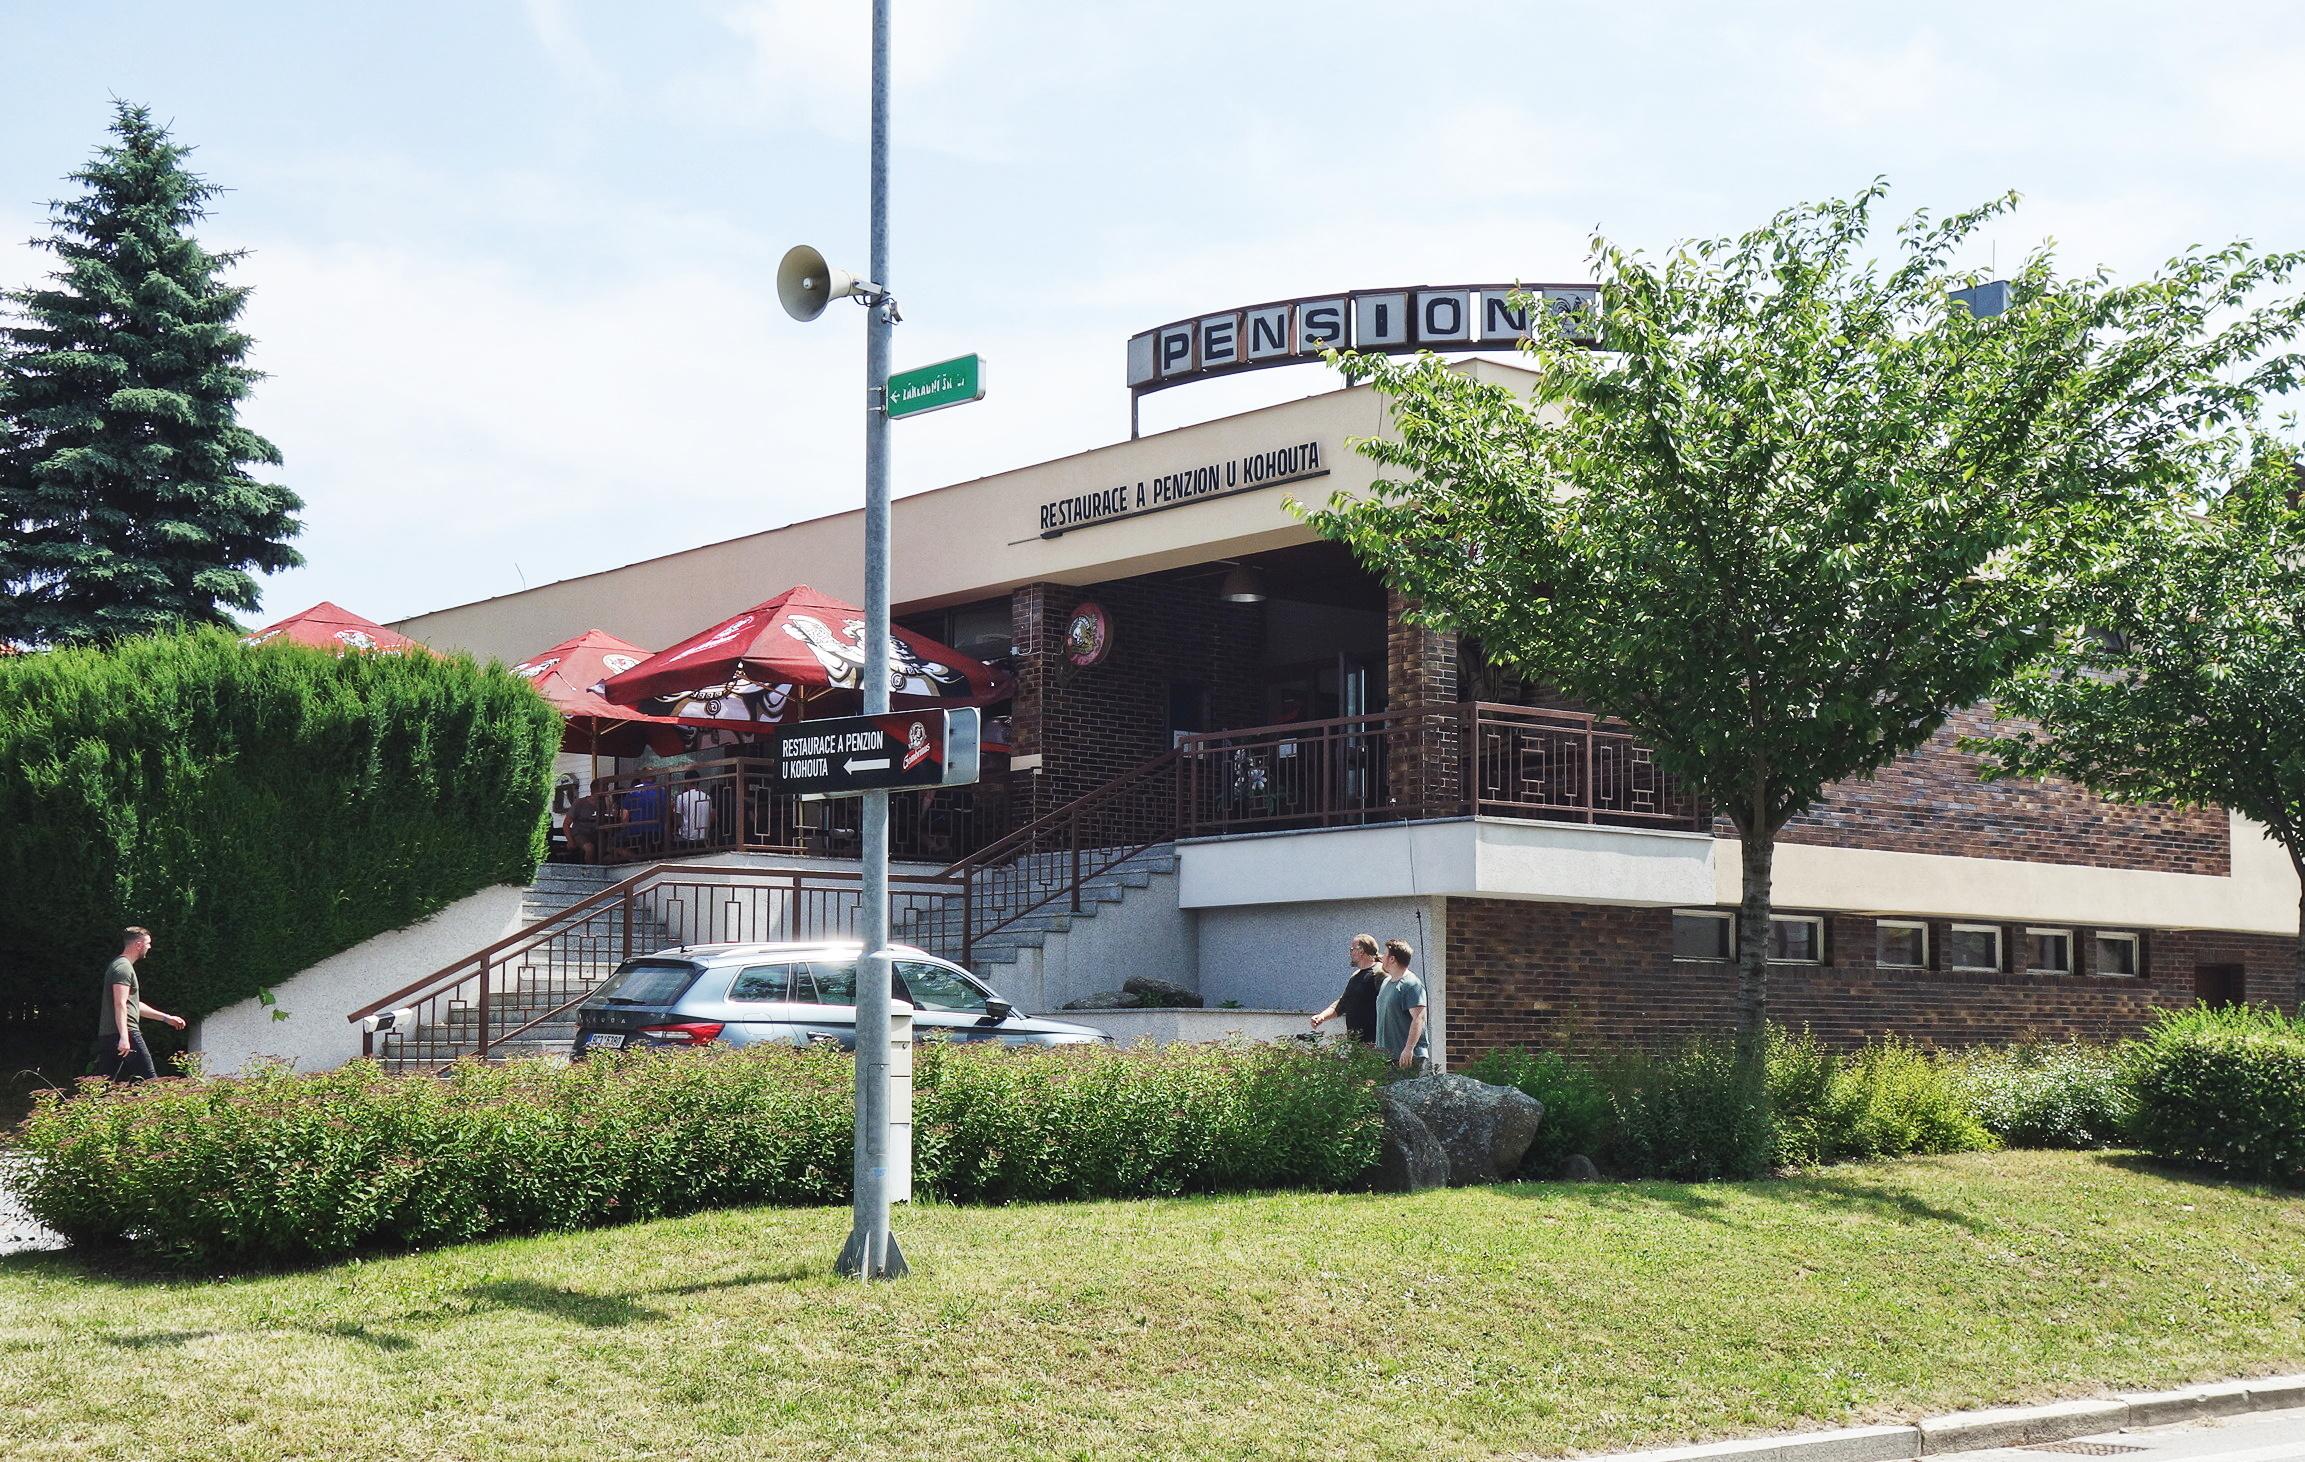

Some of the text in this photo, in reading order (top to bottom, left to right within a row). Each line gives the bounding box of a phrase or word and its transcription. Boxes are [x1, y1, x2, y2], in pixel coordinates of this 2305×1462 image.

[1164, 297, 1526, 371] PENSION
[1040, 441, 1320, 529] RESTAURACE A PENZION U KOHOUTA
[782, 730, 884, 758] RESTAURACE A PENZION
[782, 757, 829, 780] U KOHOUTA
